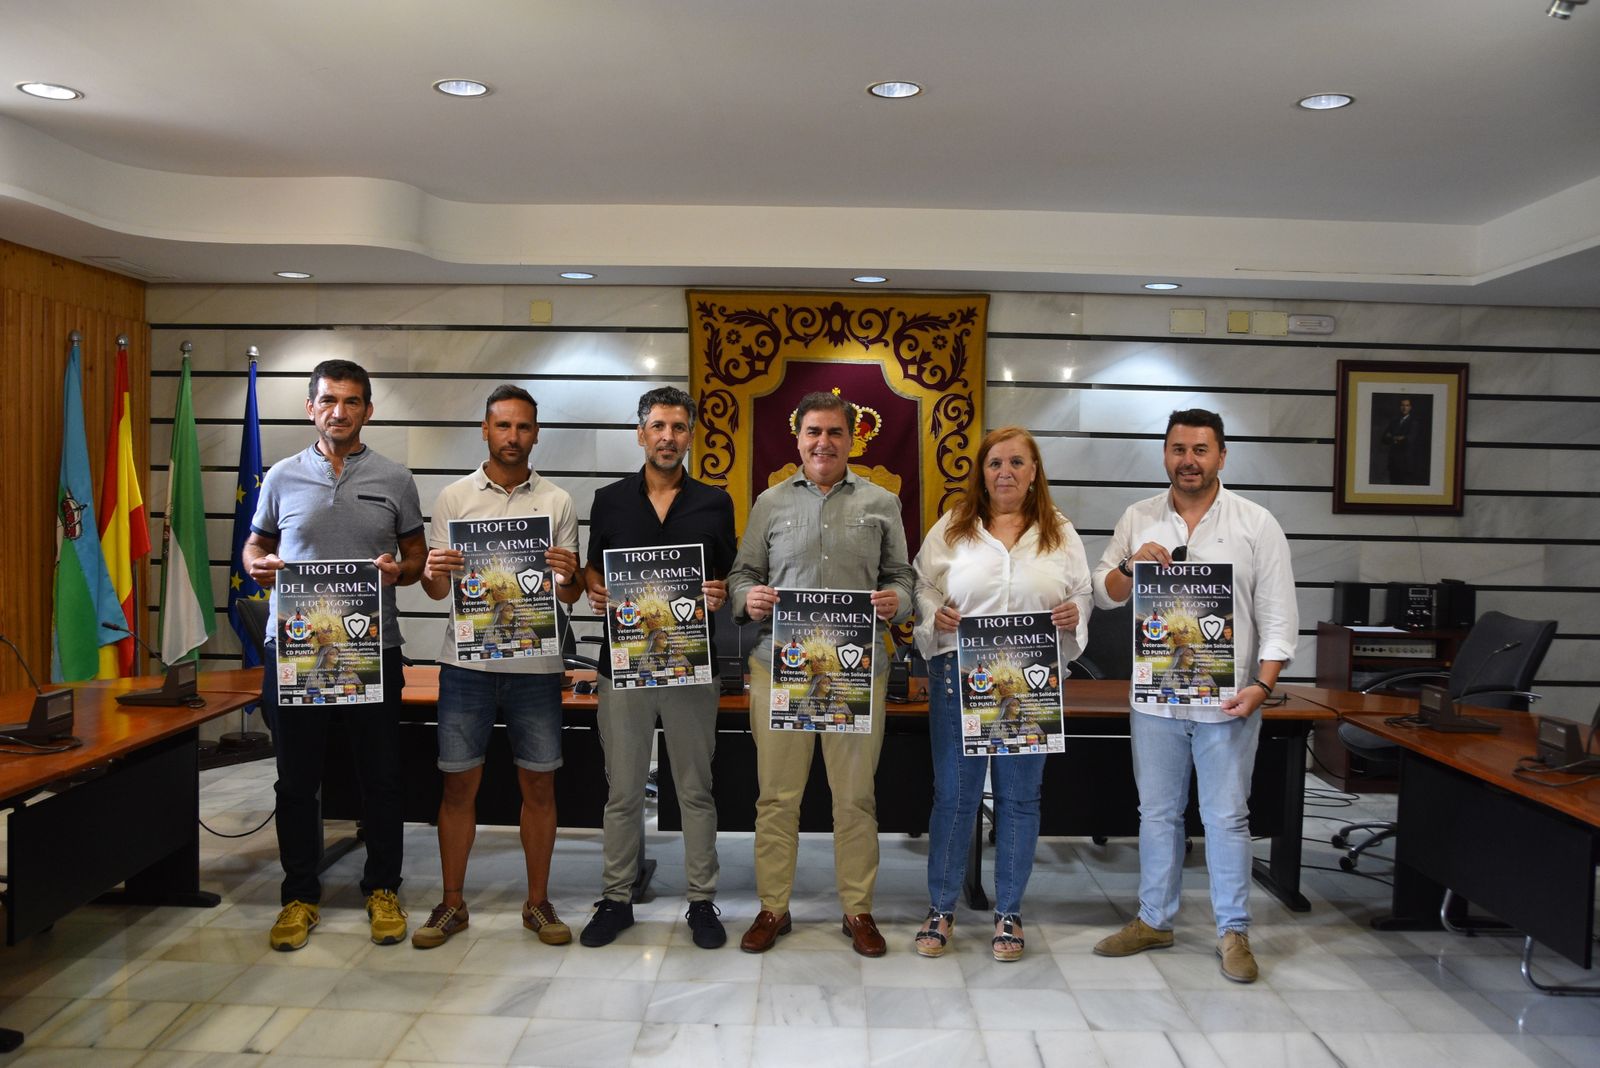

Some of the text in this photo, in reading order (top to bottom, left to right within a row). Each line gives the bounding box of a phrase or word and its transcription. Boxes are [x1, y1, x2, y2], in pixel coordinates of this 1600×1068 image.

[468, 520, 528, 534] TROFEO
[454, 538, 549, 552] DEL CARMEN
[499, 556, 536, 564] AGOSTO
[623, 549, 680, 563] TROFEO
[296, 564, 357, 575] TROFEO
[609, 571, 636, 582] DEL
[640, 567, 701, 580] CARMEN
[1153, 565, 1212, 576] TROFEO
[280, 582, 377, 593] DEL CARMEN
[653, 584, 689, 592] AGOSTO
[1138, 584, 1231, 594] DEL CARMEN
[795, 593, 852, 605] TROFEO
[778, 611, 872, 623] DEL CARMEN
[976, 616, 1034, 629] TROFEO
[821, 629, 858, 637] AGOSTO
[961, 637, 989, 648] DEL
[993, 633, 1055, 647] CARMEN
[1005, 651, 1042, 659] AGOSTO
